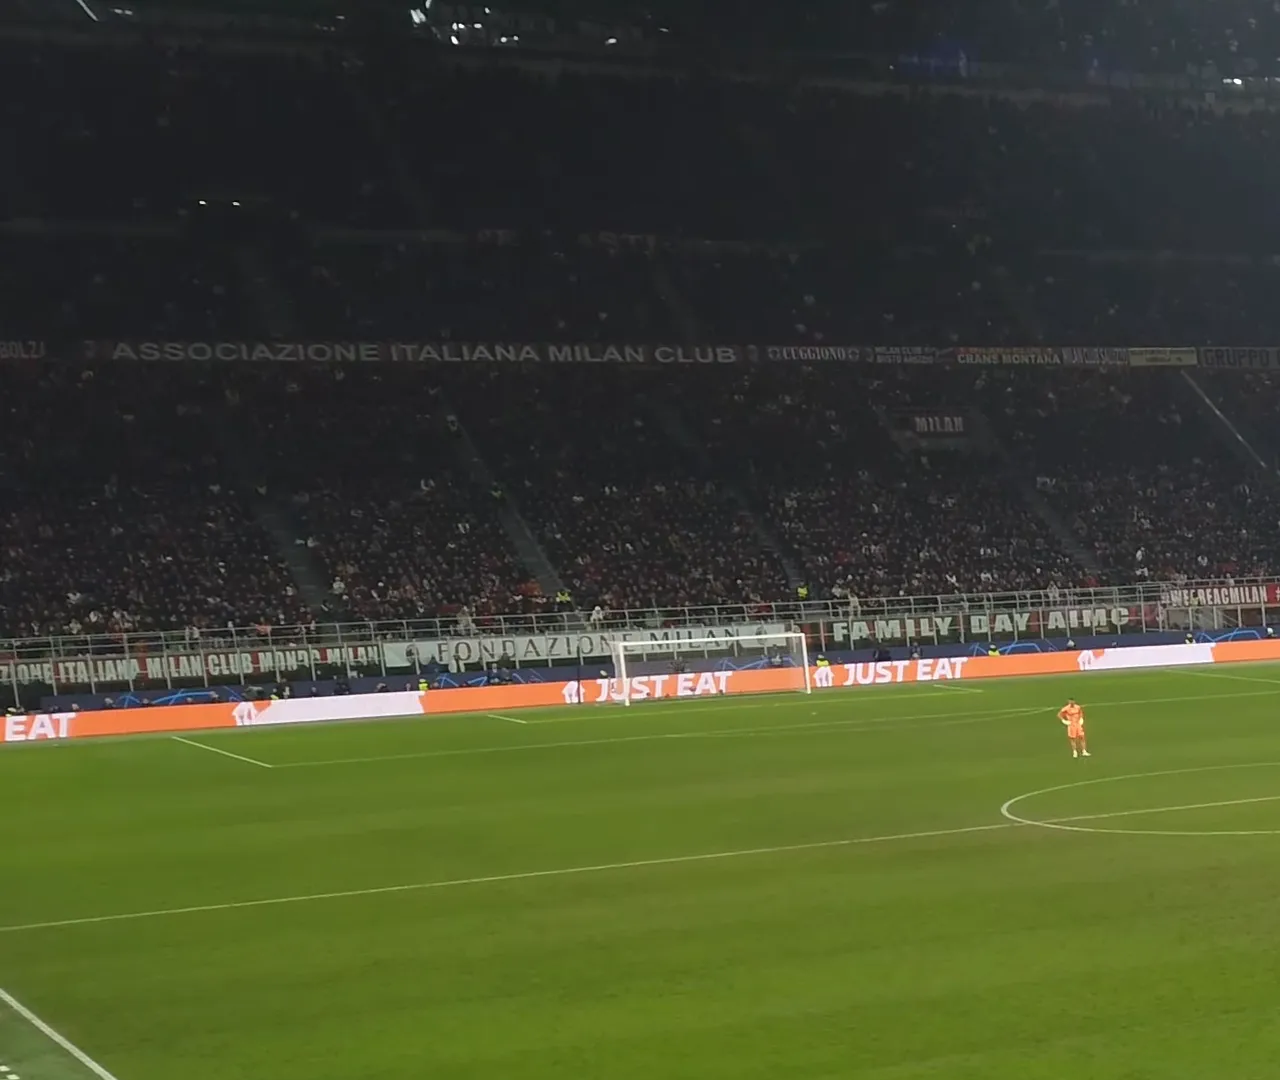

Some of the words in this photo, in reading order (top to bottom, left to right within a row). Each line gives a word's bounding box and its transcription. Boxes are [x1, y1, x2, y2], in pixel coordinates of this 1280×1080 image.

[112, 341, 381, 362] ASSOCIAZIONE
[391, 343, 539, 363] ITALIANA
[547, 343, 644, 363] MILAN
[654, 345, 737, 364] CLUB
[782, 346, 846, 360] CUGGIONO
[957, 353, 998, 364] CRANS
[1001, 353, 1061, 365] MONTANA
[1203, 348, 1270, 367] GRUPPO
[914, 416, 964, 432] MILAN
[833, 616, 954, 643] FAMILY
[970, 613, 1032, 635] DAY
[1048, 608, 1130, 629] AIMC
[438, 633, 633, 661] FONDAZIONE
[649, 628, 740, 649] MILAN
[58, 660, 139, 684] ITALIANA
[207, 653, 254, 675] CLUB
[843, 660, 913, 685] JUST
[916, 656, 968, 682] EAT
[595, 674, 669, 702] JUST
[676, 670, 733, 697] EAT
[4, 711, 78, 742] EAT
